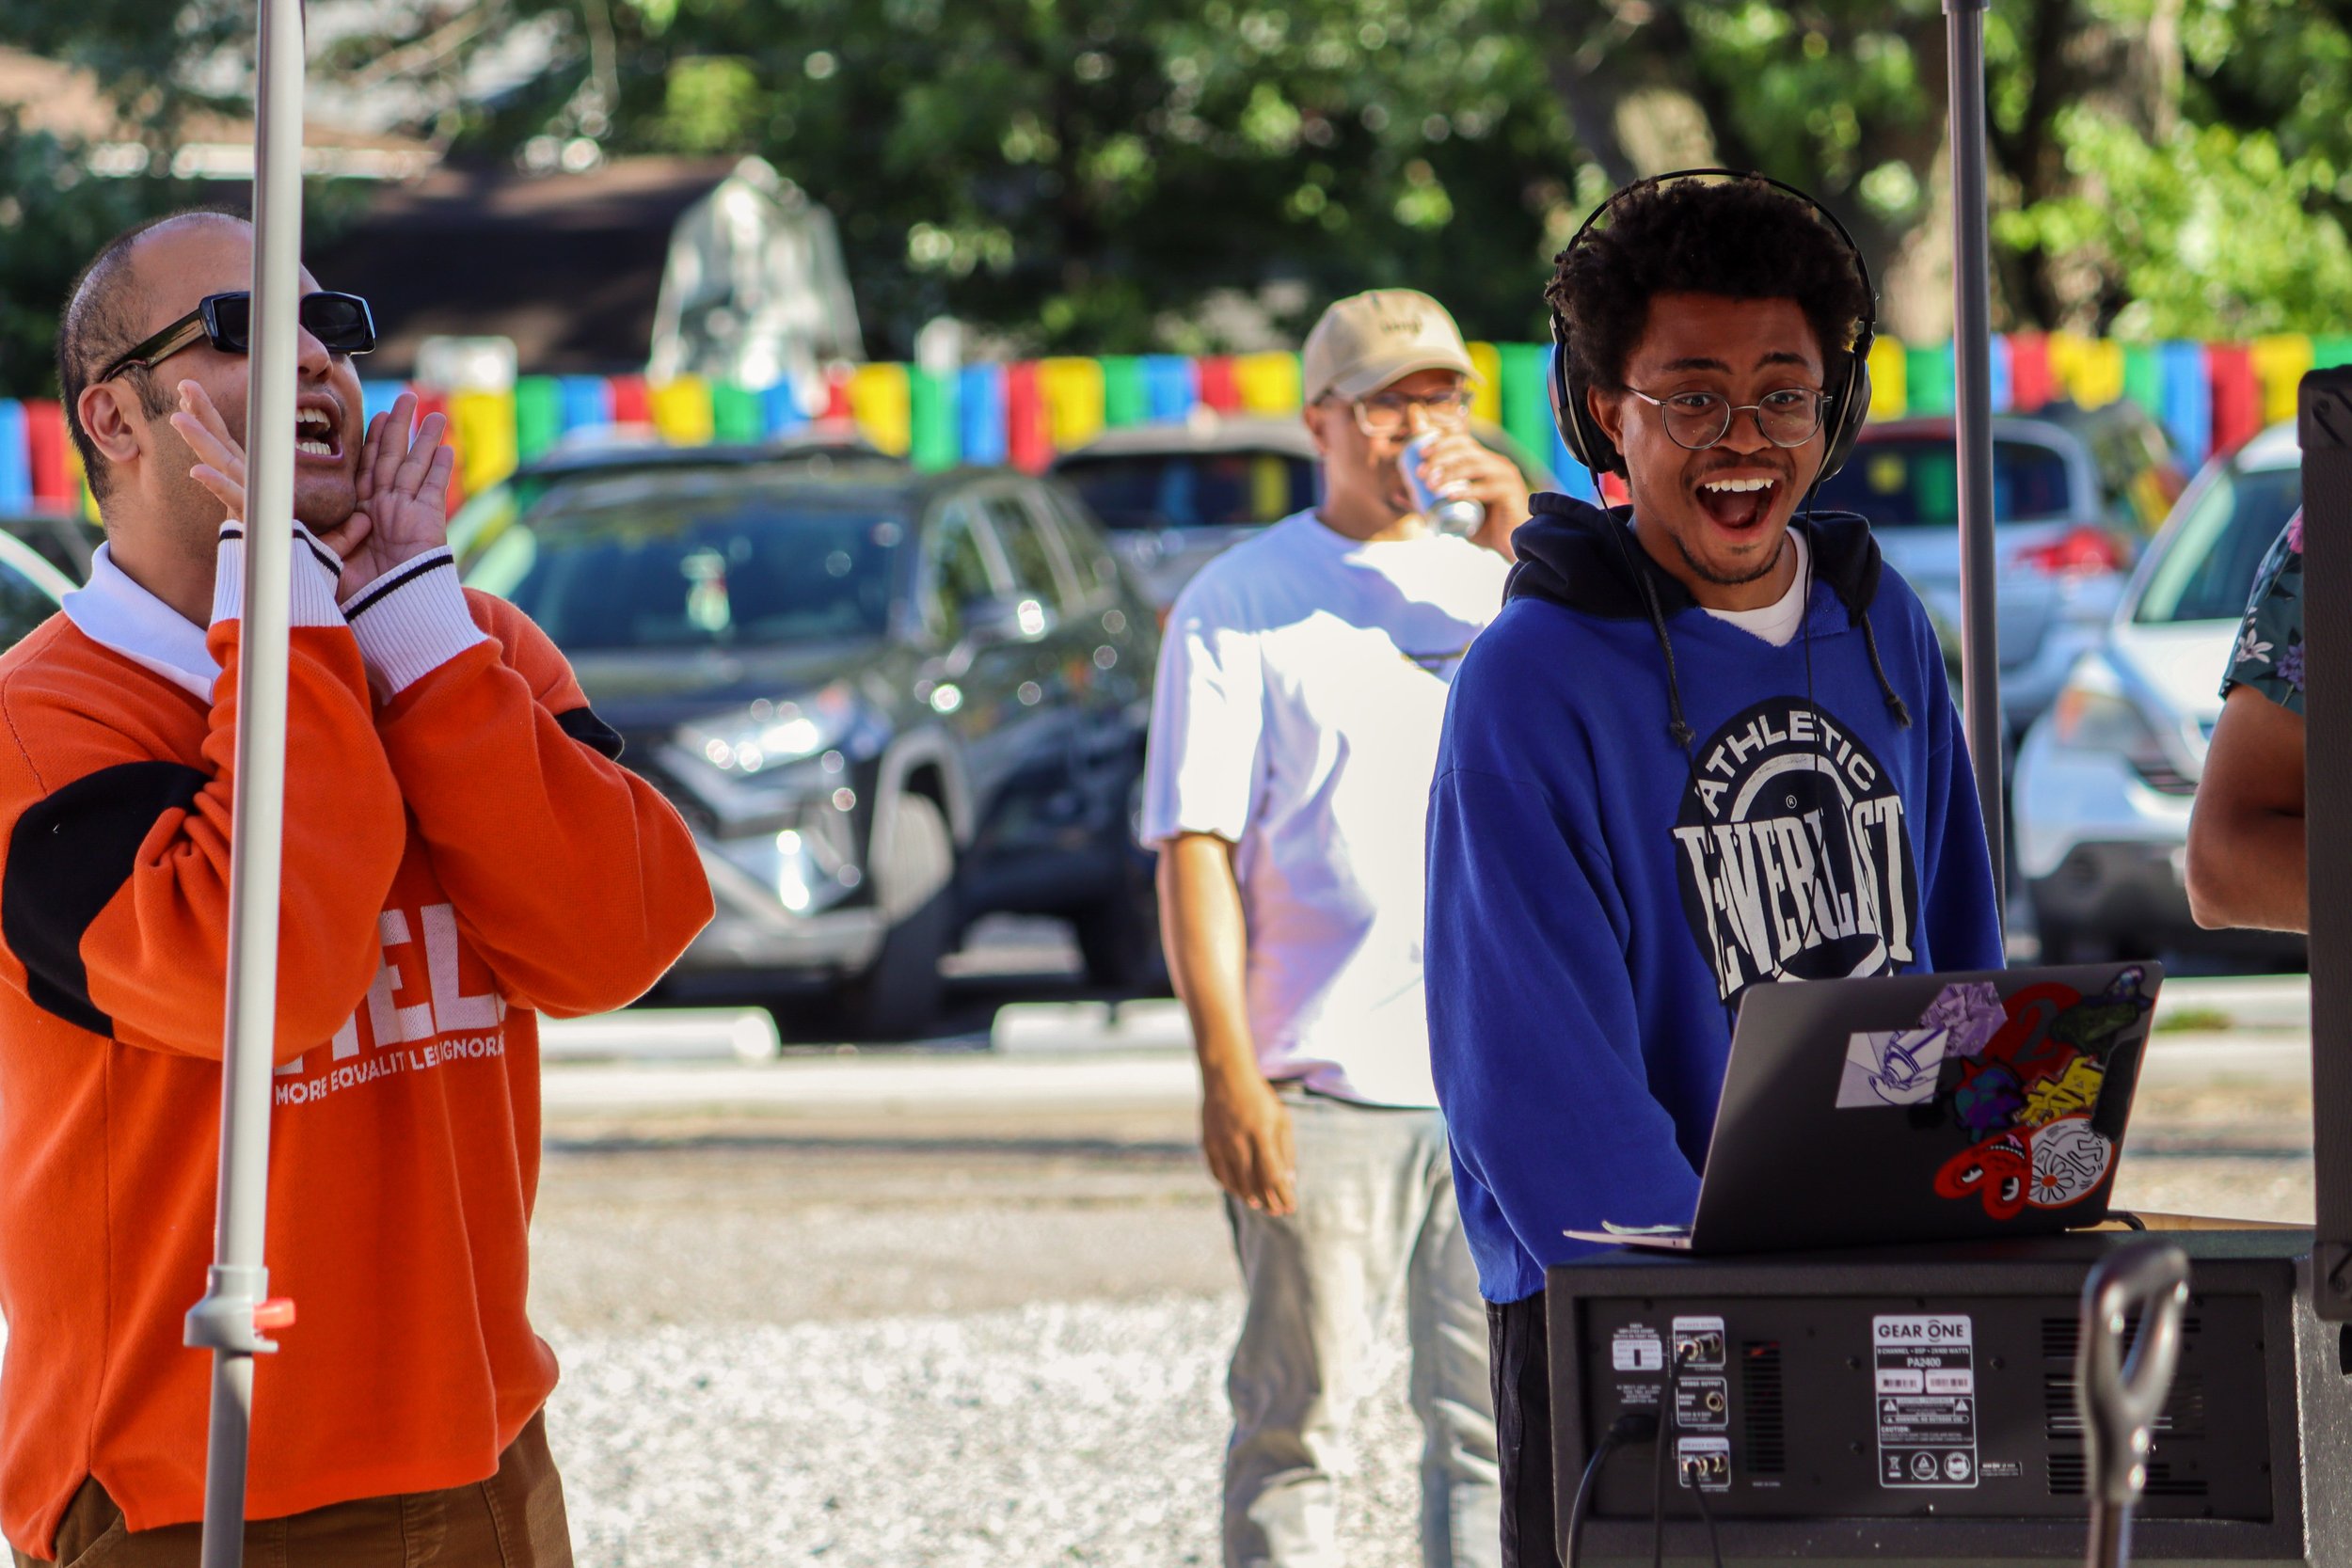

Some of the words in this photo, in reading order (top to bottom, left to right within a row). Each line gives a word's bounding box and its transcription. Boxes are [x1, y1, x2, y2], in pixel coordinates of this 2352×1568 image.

[1694, 710, 1876, 817] ATHLETIC
[1673, 795, 1913, 1001] EVERLST
[276, 1076, 327, 1105] MORE
[1879, 1323, 1922, 1338] GEAR
[1928, 1323, 1964, 1338] ONE
[1907, 1357, 1942, 1368] PA2400
